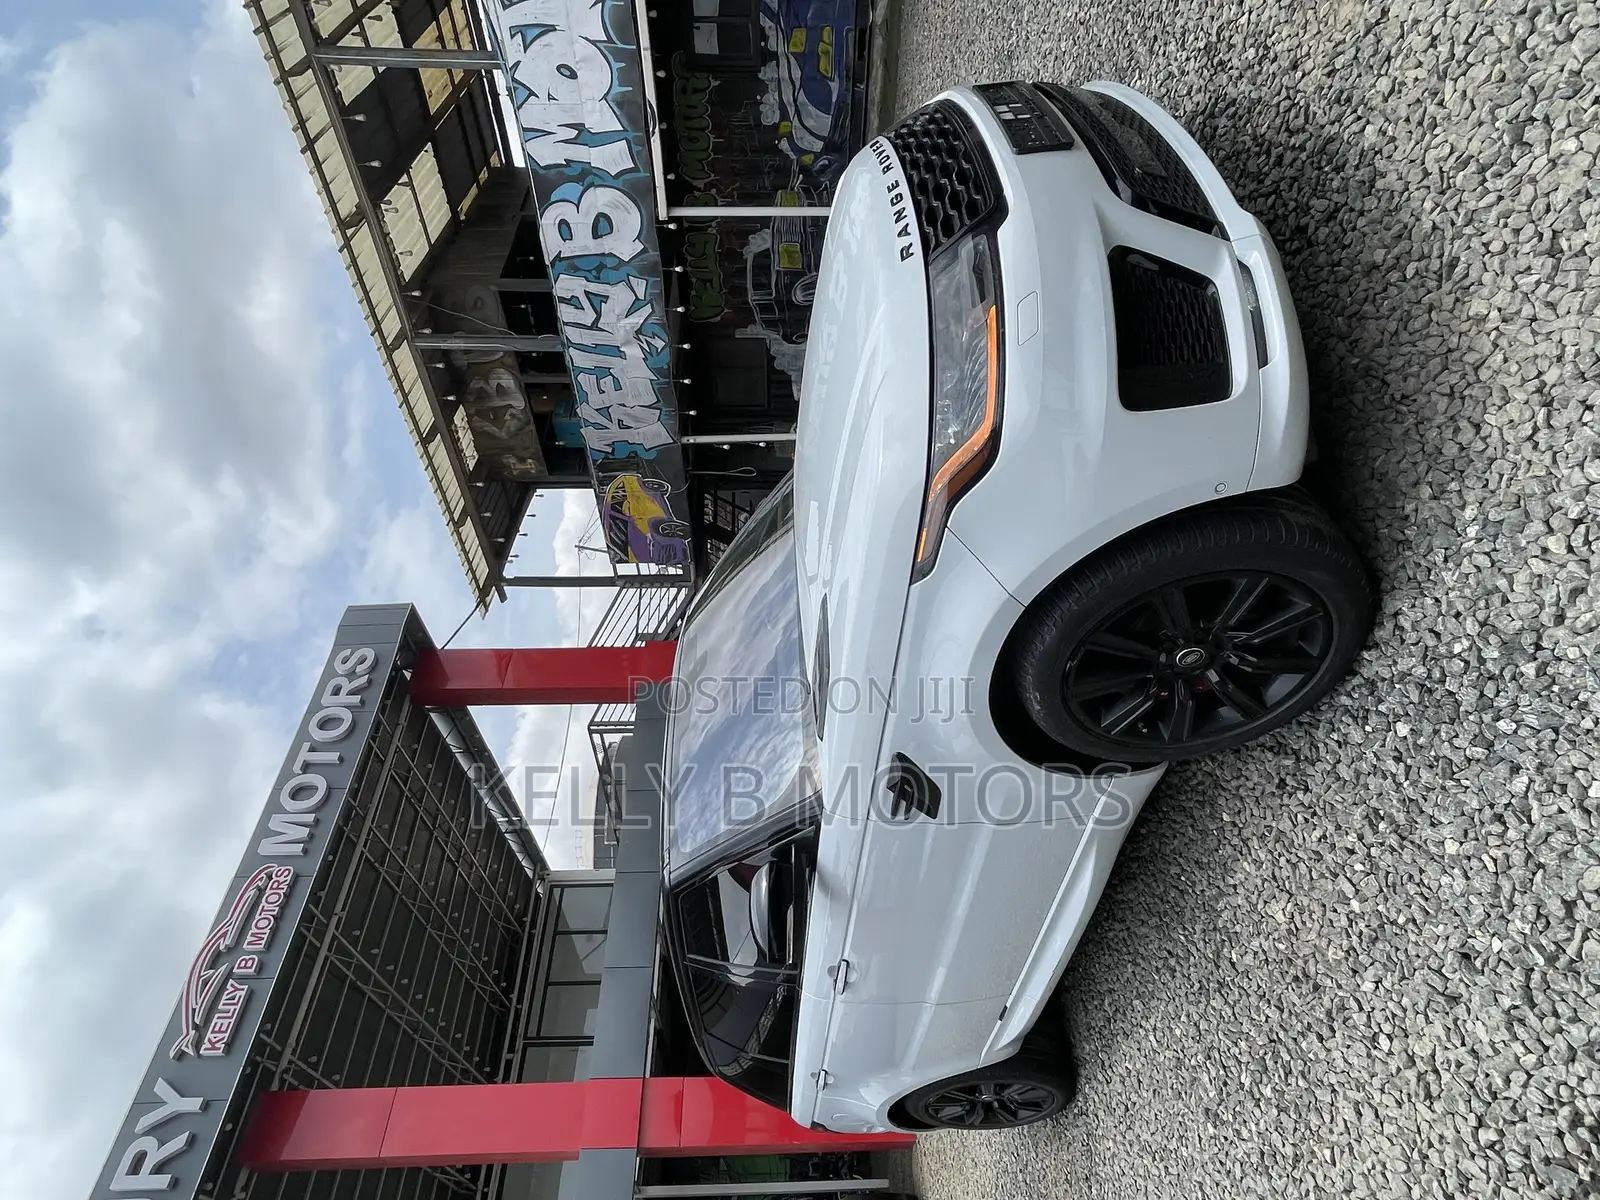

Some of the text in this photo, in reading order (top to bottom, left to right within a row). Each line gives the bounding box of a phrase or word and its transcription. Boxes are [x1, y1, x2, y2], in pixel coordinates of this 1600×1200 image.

[499, 0, 676, 452] KELLY B MOT
[684, 232, 724, 322] KELLY
[869, 139, 916, 262] RANGE ROVER
[257, 646, 378, 855] MOTORS
[200, 865, 294, 1056] KELLY B MOTORS
[108, 1077, 207, 1200] RY
